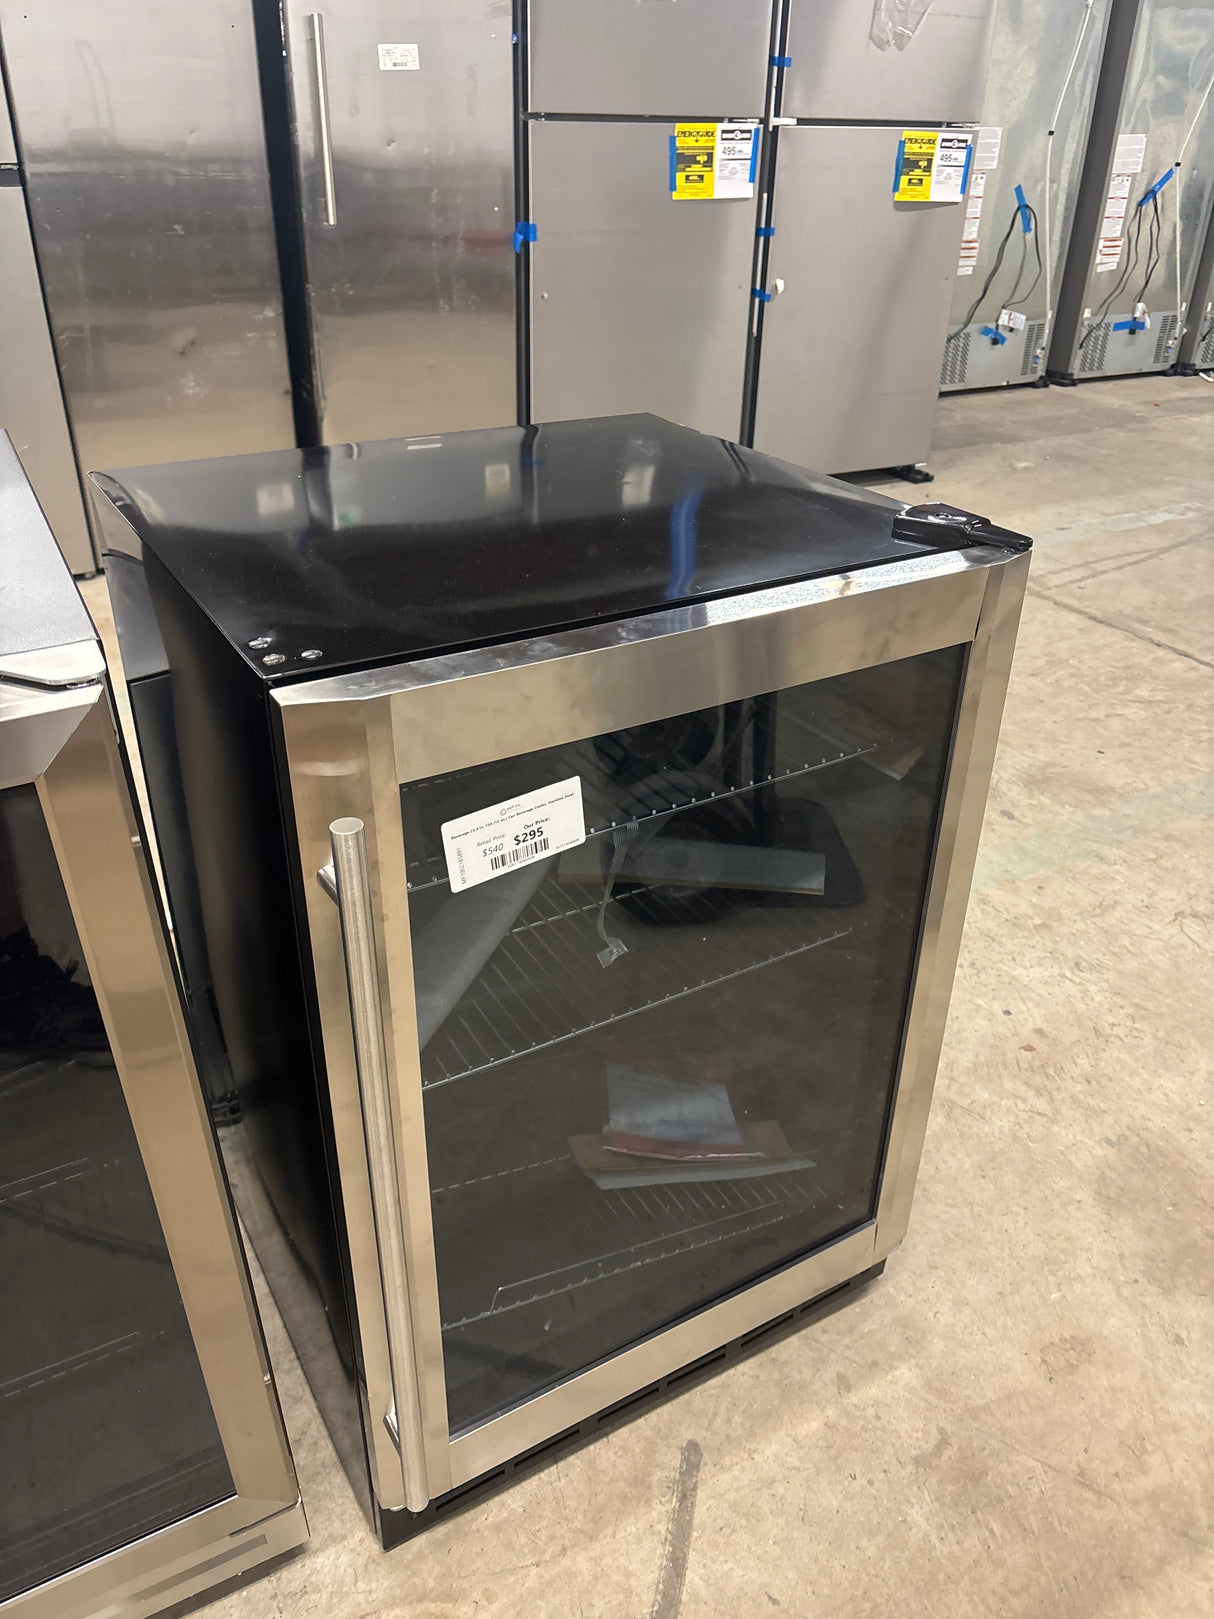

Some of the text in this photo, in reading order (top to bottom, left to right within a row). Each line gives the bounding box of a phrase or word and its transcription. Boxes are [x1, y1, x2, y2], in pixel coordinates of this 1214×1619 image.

[722, 146, 736, 156] 495
[940, 153, 953, 163] 495
[451, 832, 470, 840] Beverage
[516, 808, 533, 816] Beverage
[523, 817, 550, 830] Our Price:
[477, 838, 491, 847] Retail
[513, 826, 544, 846] $295
[482, 842, 504, 857] $540
